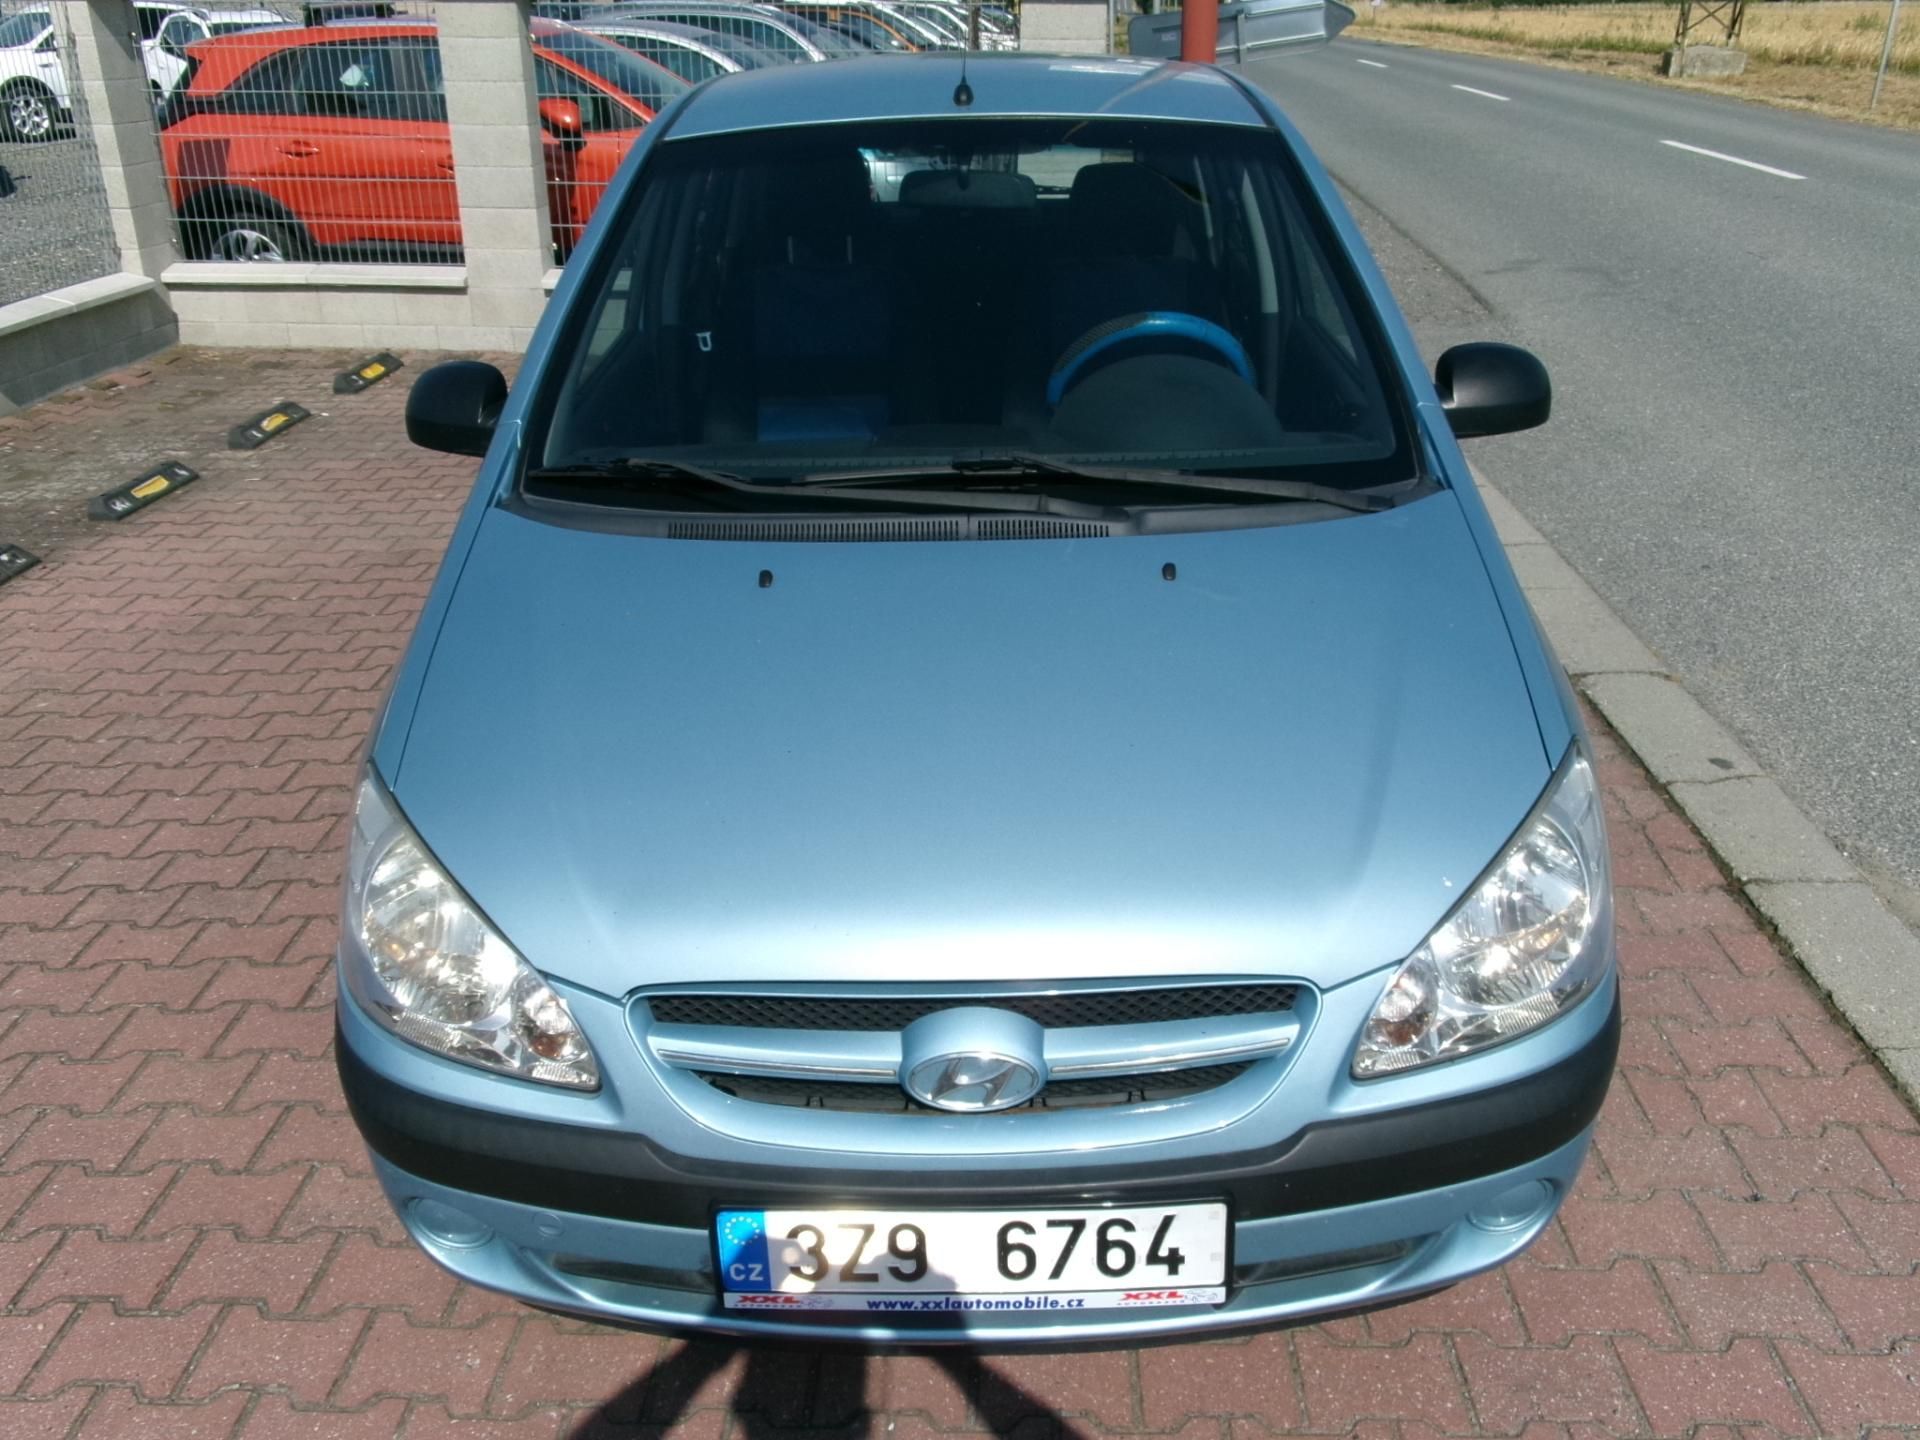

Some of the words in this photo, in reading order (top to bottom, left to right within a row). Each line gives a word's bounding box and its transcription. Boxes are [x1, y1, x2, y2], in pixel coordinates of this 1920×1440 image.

[785, 1223, 928, 1282] 3Z9
[996, 1214, 1186, 1281] 6764
[729, 1263, 763, 1281] CZ
[738, 1295, 801, 1304] XXL
[1120, 1290, 1185, 1301] XXL
[866, 1296, 1085, 1310] www.xxlautomobile.cz
